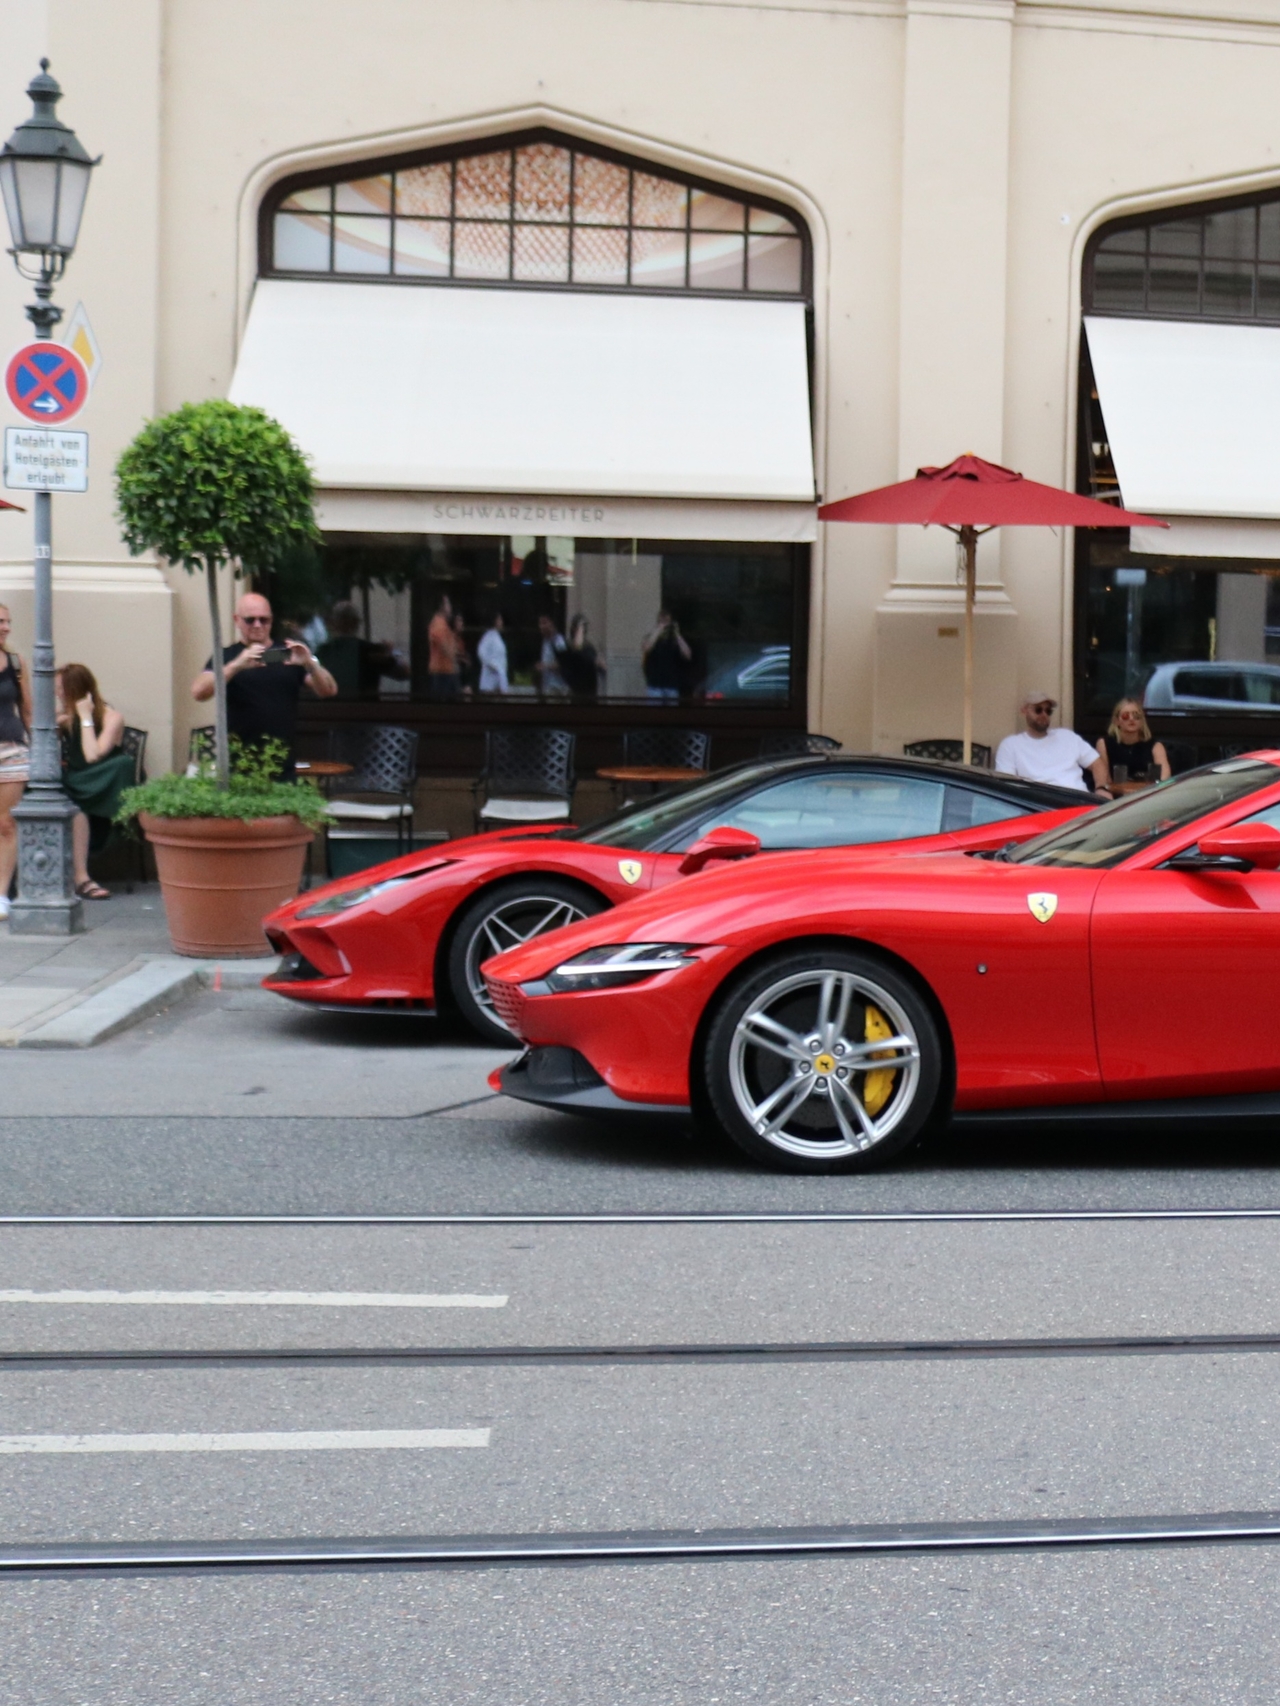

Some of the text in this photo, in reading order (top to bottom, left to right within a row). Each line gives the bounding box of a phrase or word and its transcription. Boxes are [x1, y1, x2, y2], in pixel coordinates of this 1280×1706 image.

[15, 434, 80, 450] Anfahrt von
[15, 452, 78, 469] Hotelgästen
[27, 472, 66, 485] erlaubt
[433, 504, 605, 523] SCHWARZREITER
